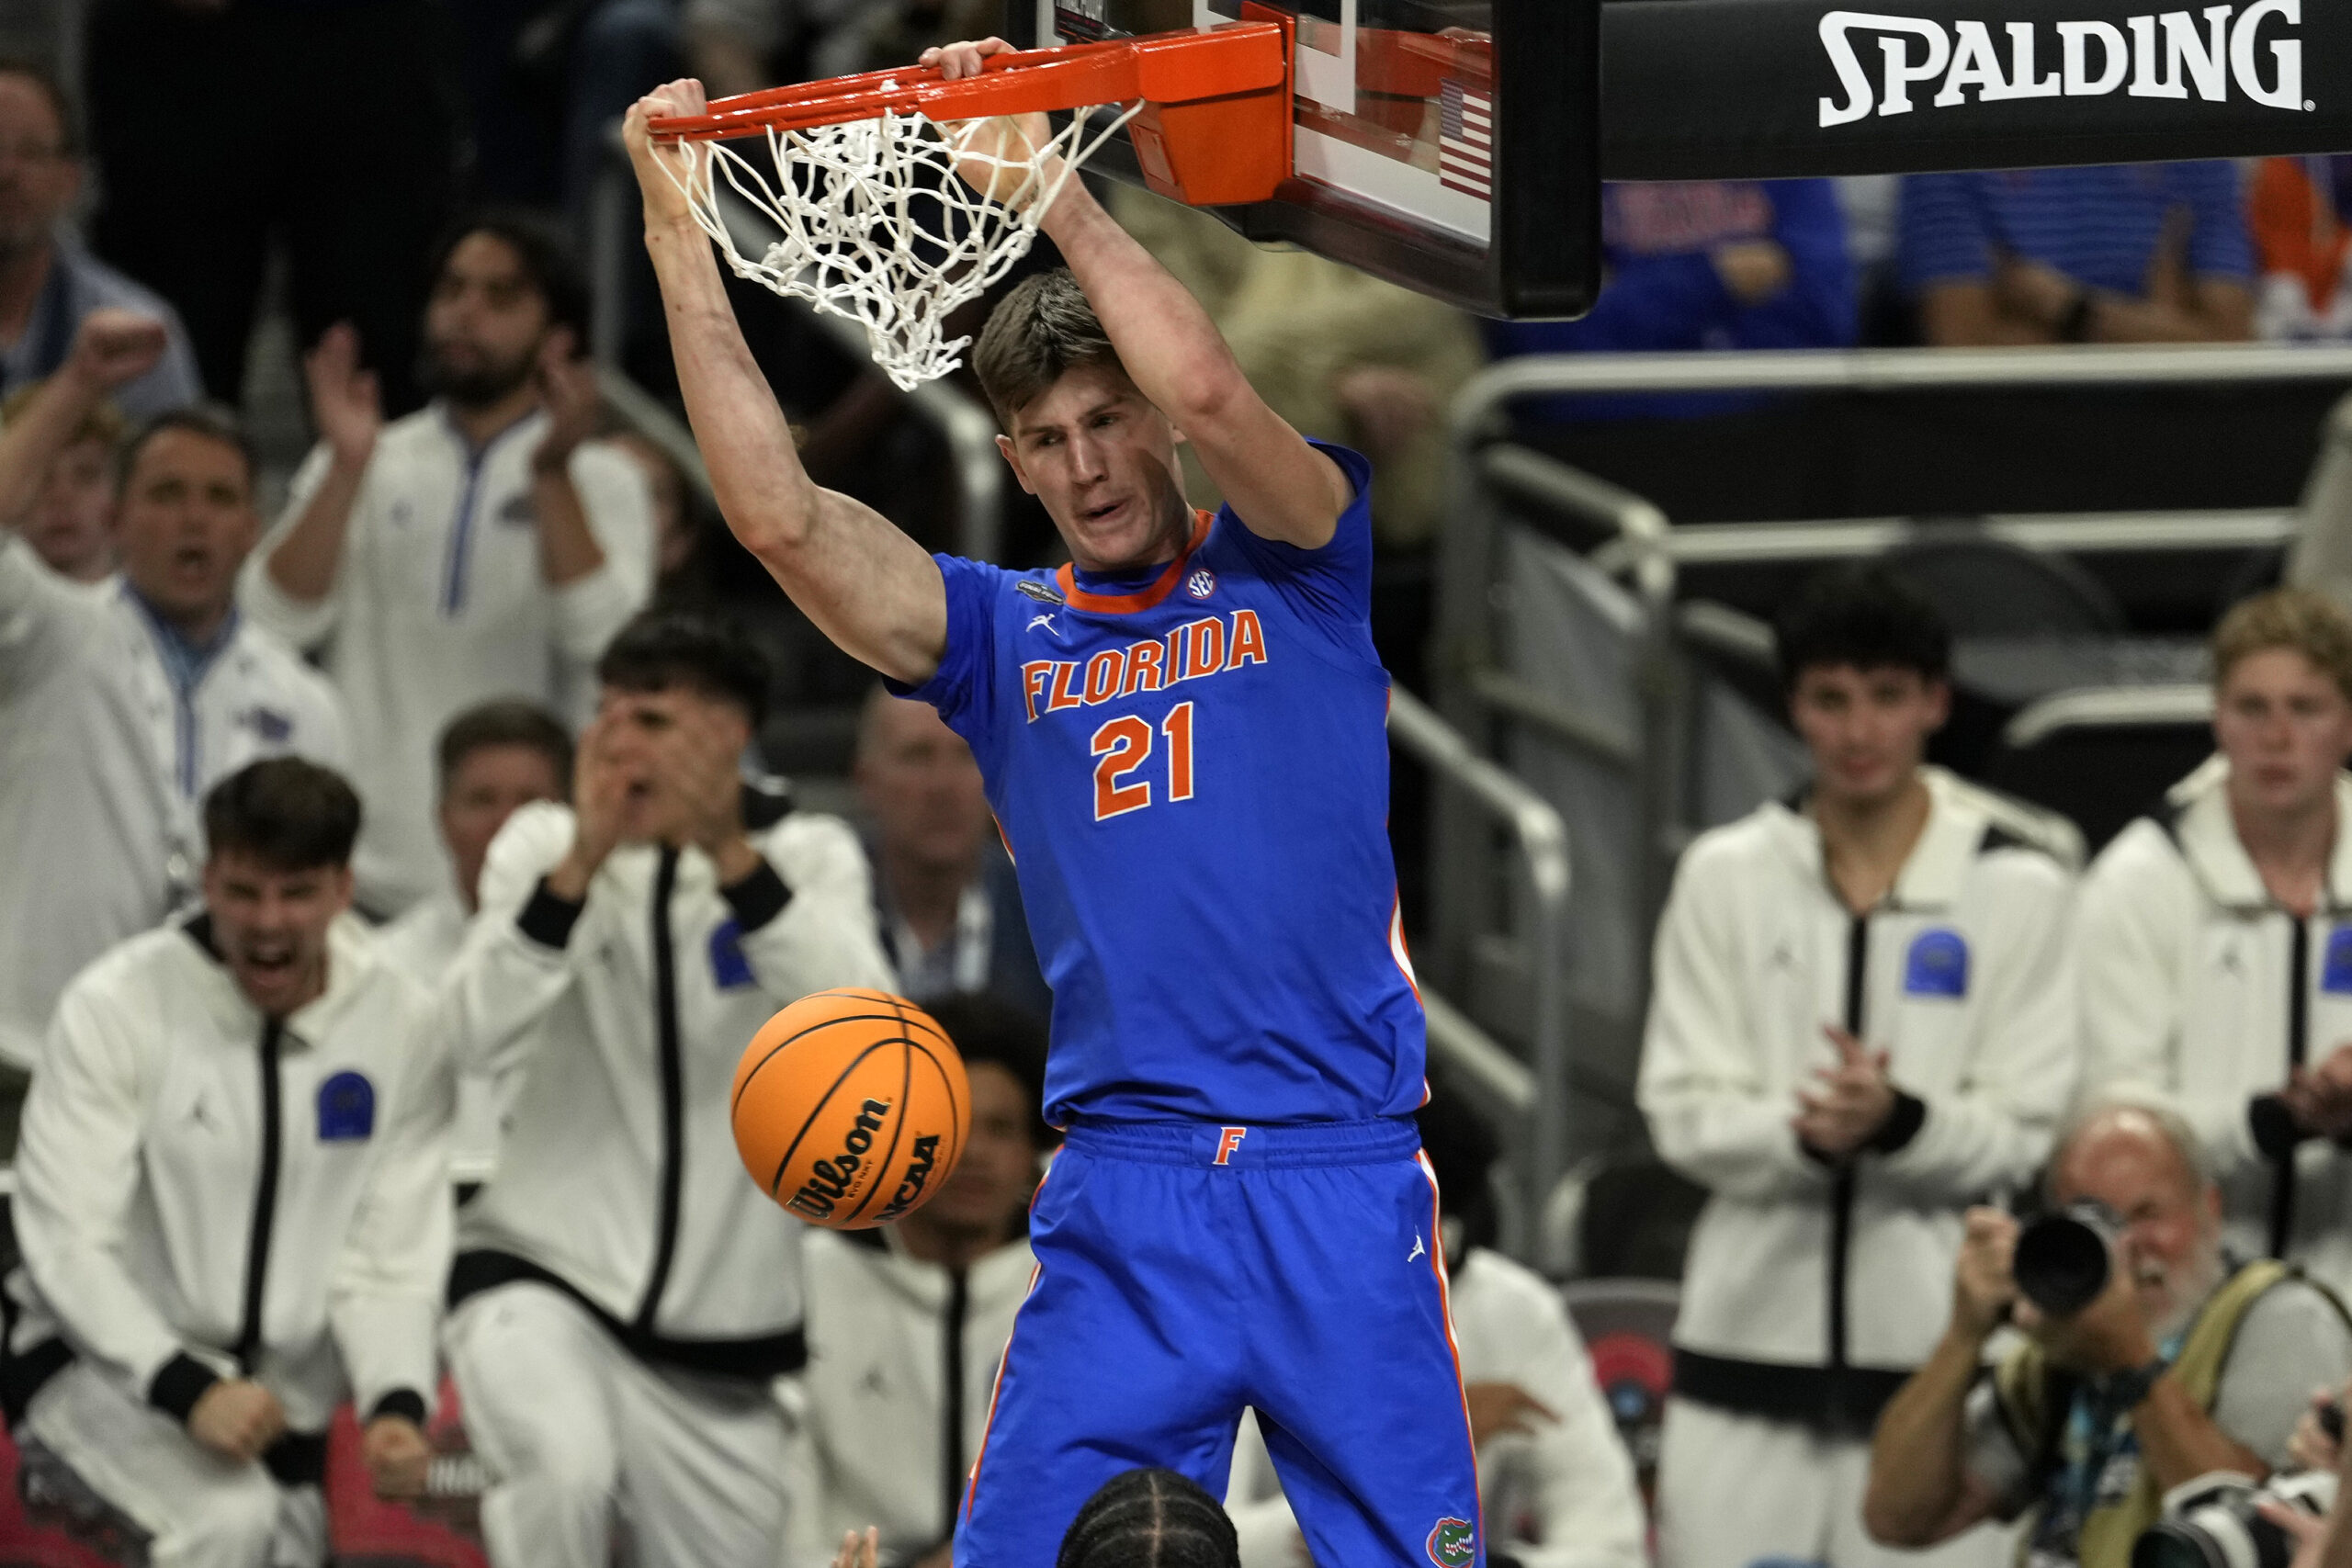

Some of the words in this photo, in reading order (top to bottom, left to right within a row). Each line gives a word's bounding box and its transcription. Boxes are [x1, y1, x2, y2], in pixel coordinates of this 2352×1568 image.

[1819, 0, 2302, 128] SPALDING
[1188, 570, 1214, 597] SEC
[1020, 609, 1268, 724] FLORIDA
[1091, 701, 1193, 821] 21
[786, 1097, 891, 1220] Wilson
[872, 1134, 941, 1221] NCAA
[1212, 1127, 1247, 1165] F
